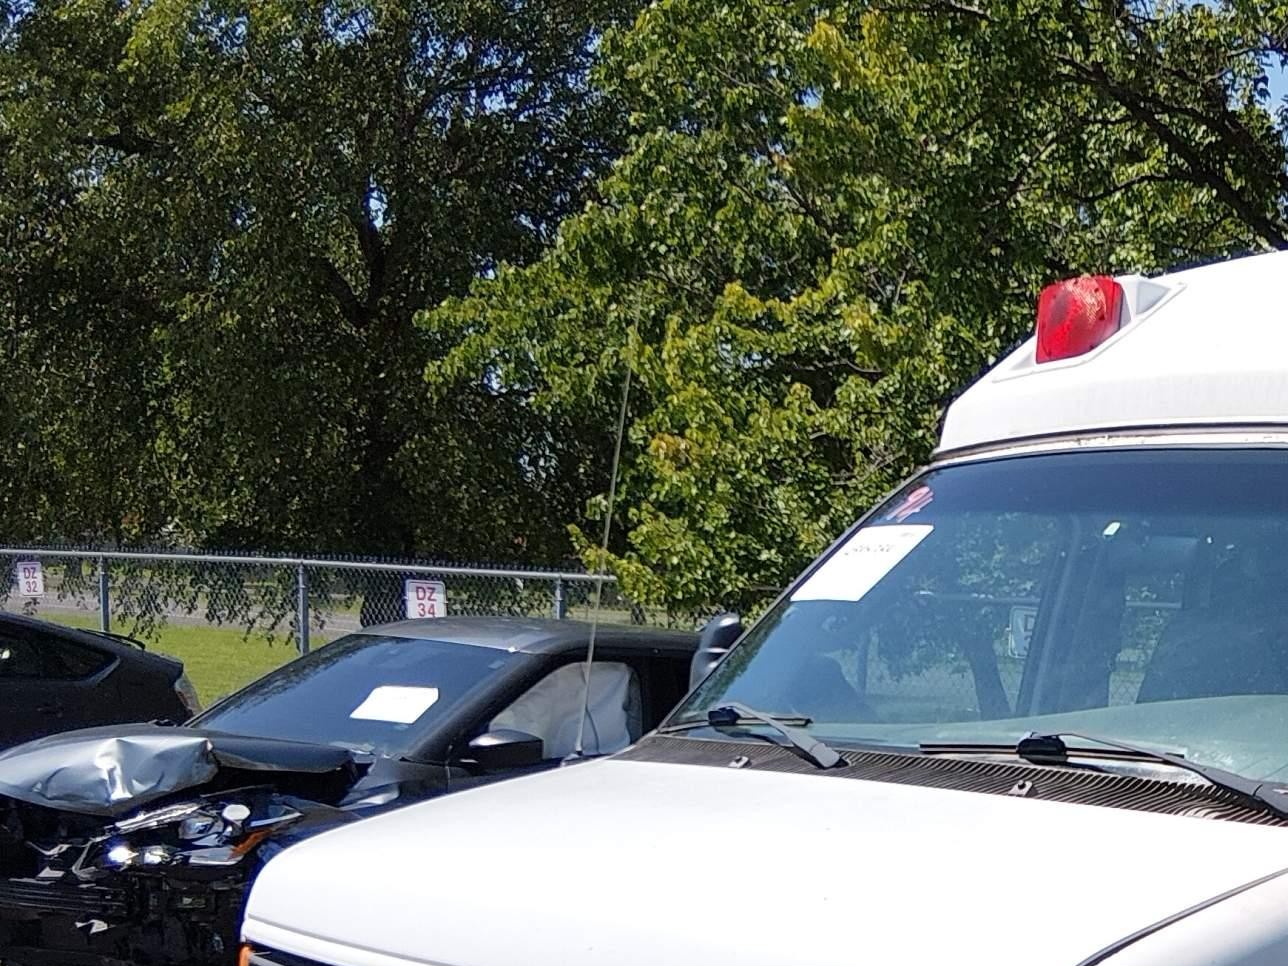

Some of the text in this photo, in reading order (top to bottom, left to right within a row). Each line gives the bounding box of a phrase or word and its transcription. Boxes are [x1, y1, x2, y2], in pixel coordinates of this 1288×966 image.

[23, 567, 38, 580] DZ
[26, 581, 38, 593] 32
[416, 586, 437, 601] DZ
[417, 603, 436, 618] 34
